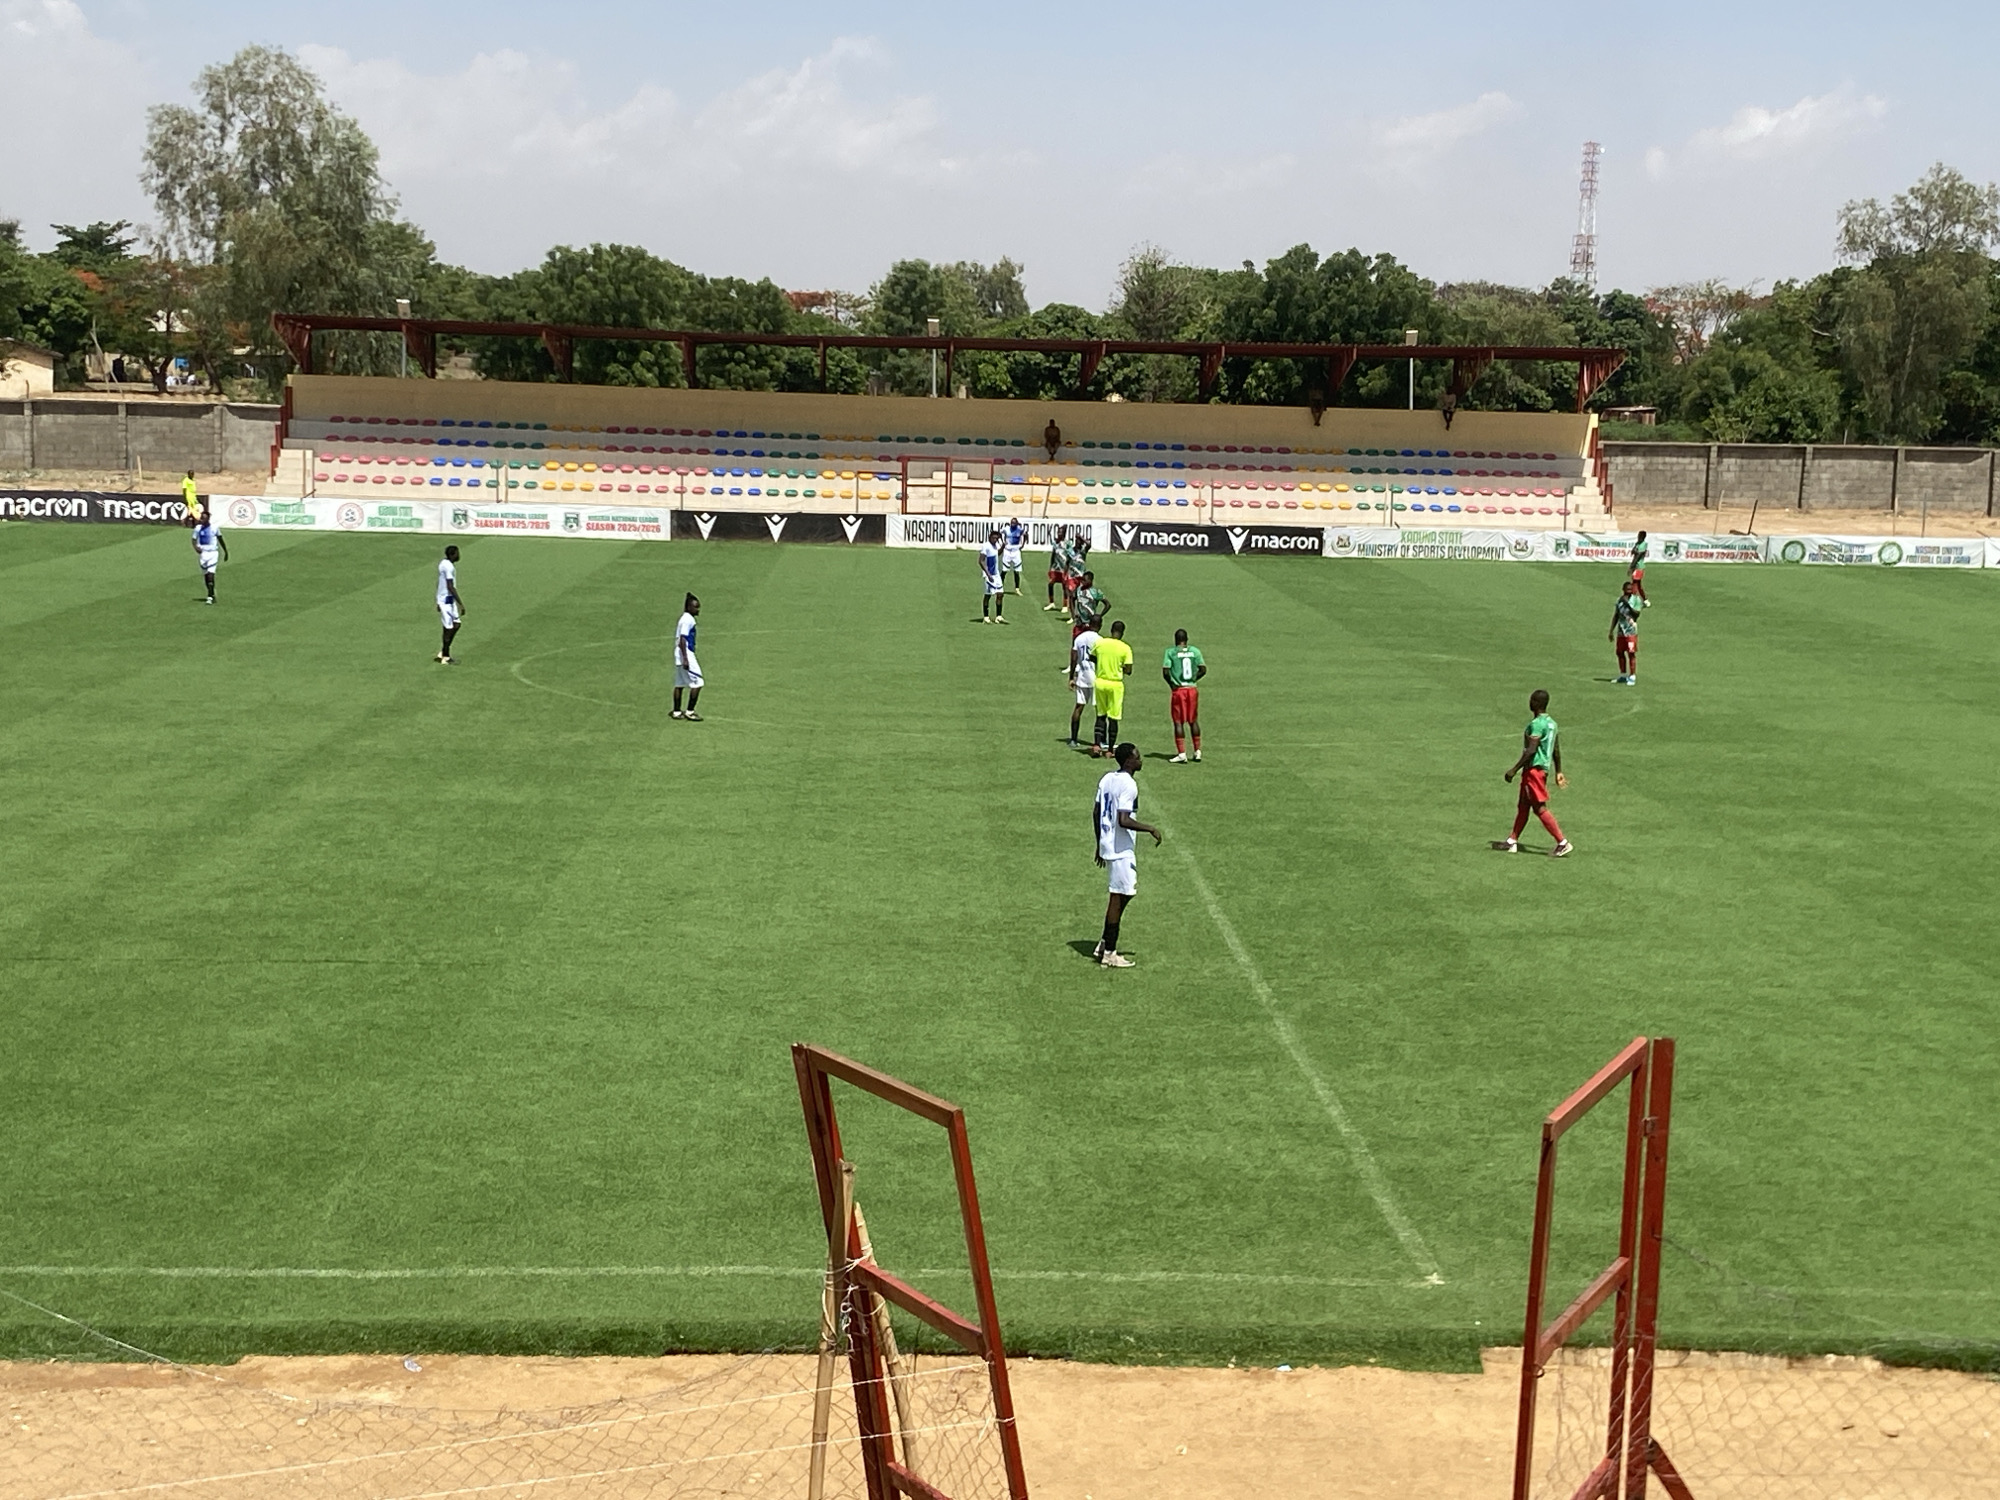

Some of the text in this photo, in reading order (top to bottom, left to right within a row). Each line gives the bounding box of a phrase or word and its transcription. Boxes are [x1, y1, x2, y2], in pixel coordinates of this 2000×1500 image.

[474, 519, 505, 528] SEASON
[586, 522, 661, 533] SEASON 2025/2026
[904, 520, 946, 543] NASARA
[1140, 531, 1209, 547] macron
[1400, 530, 1463, 545] KADUNA STATE
[1251, 534, 1319, 550] macron
[1357, 543, 1506, 560] MINISTRY OF SPORTS DEVELOPMENT
[1575, 547, 1650, 558] SEASON 2025/
[1685, 550, 1714, 559] SEASON
